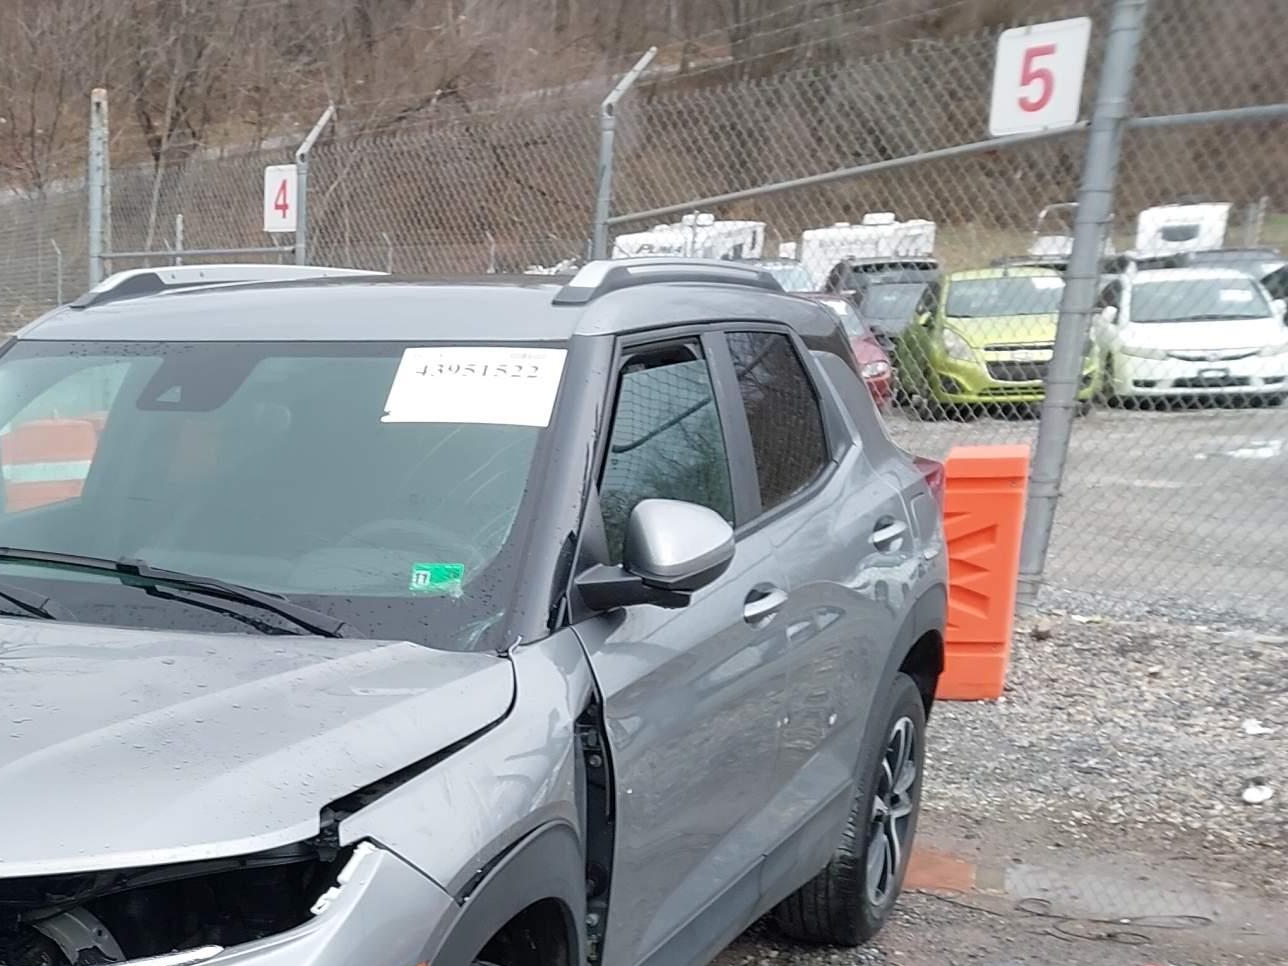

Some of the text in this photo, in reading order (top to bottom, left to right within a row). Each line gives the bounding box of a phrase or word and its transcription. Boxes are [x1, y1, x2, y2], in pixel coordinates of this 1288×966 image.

[1017, 42, 1057, 113] 5
[274, 178, 289, 219] 4
[415, 363, 540, 379] 43951522
